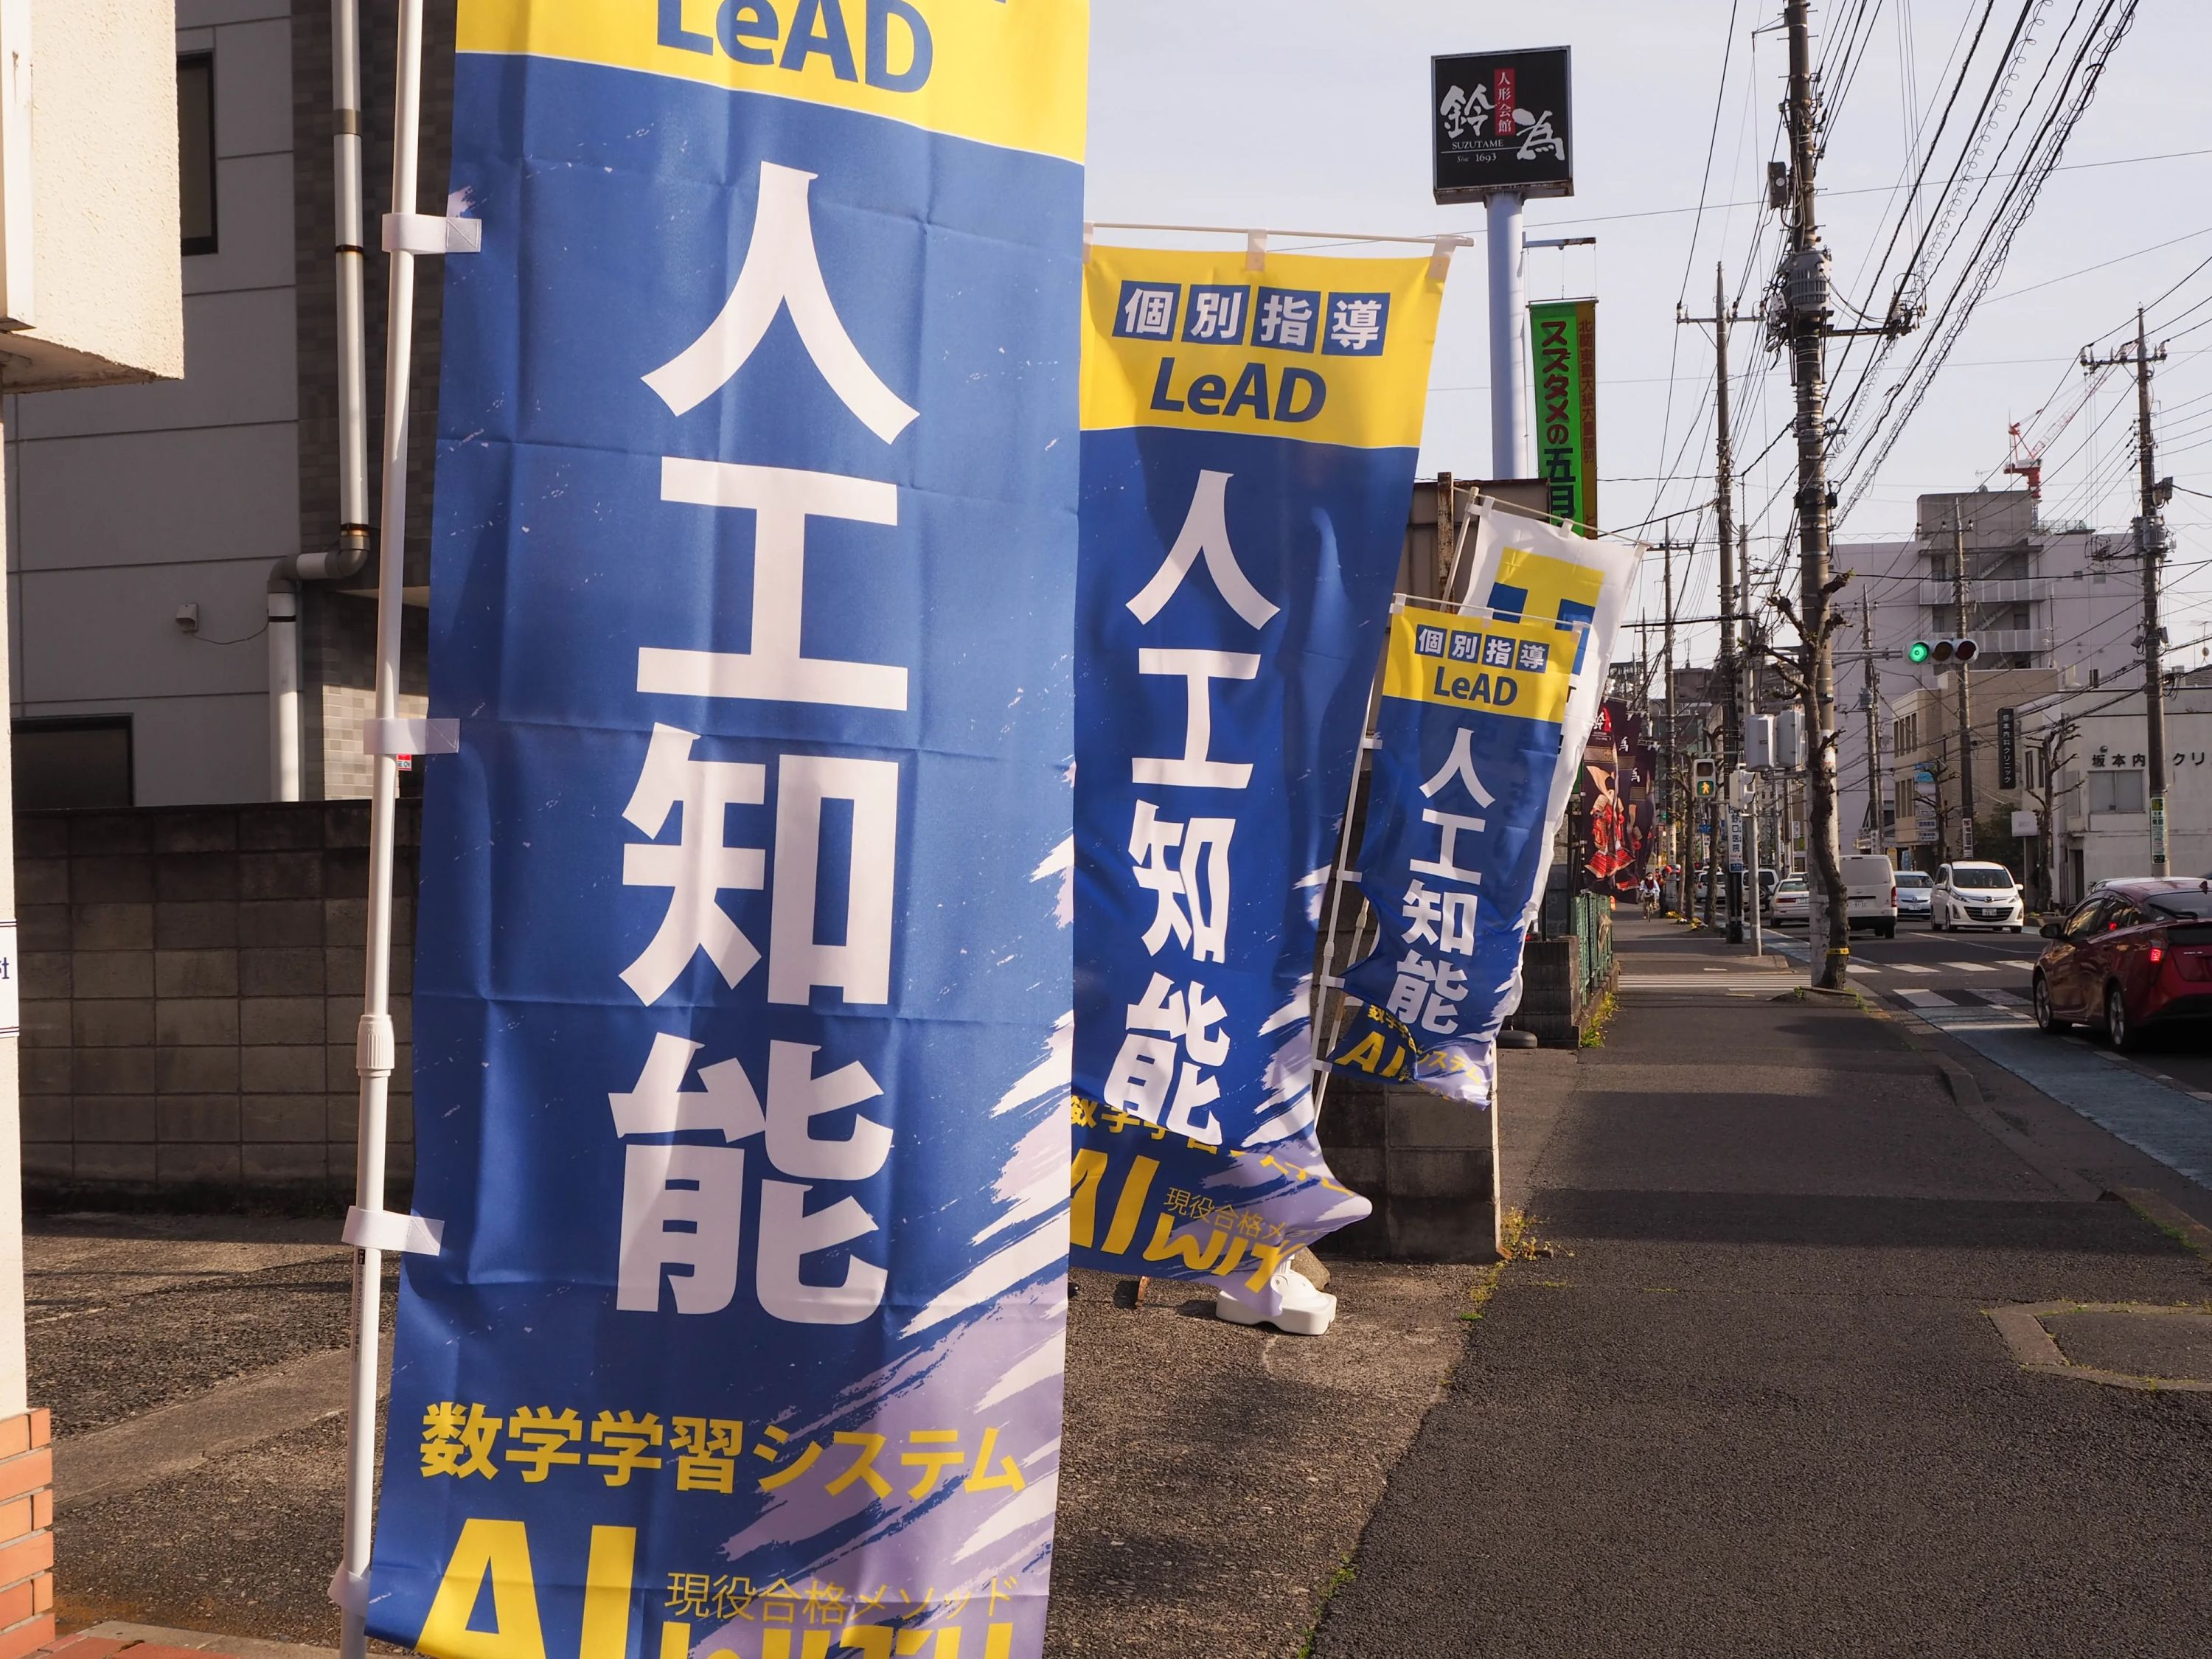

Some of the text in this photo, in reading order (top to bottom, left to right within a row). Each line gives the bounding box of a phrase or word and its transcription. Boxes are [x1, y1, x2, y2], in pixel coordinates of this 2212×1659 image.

[1498, 72, 1512, 133] 人形会館
[1452, 139, 1504, 150] SUZUTAME
[1475, 153, 1497, 163] 1693
[1124, 288, 1382, 350] 個別指導
[1150, 357, 1327, 423] LeAD
[1419, 627, 1545, 669] 個別指導
[1433, 666, 1518, 707] LeAD
[608, 161, 920, 1325] 人工知能
[2092, 752, 2212, 768] 坂本内クリ
[1104, 469, 1281, 1145] 人工知能
[1386, 727, 1496, 1034] 人工知能
[1334, 1031, 1405, 1078] AI
[419, 1402, 1027, 1501] 数学学習システム
[417, 1517, 636, 1659] AI
[664, 1571, 1018, 1625] 現役合格メソッド
